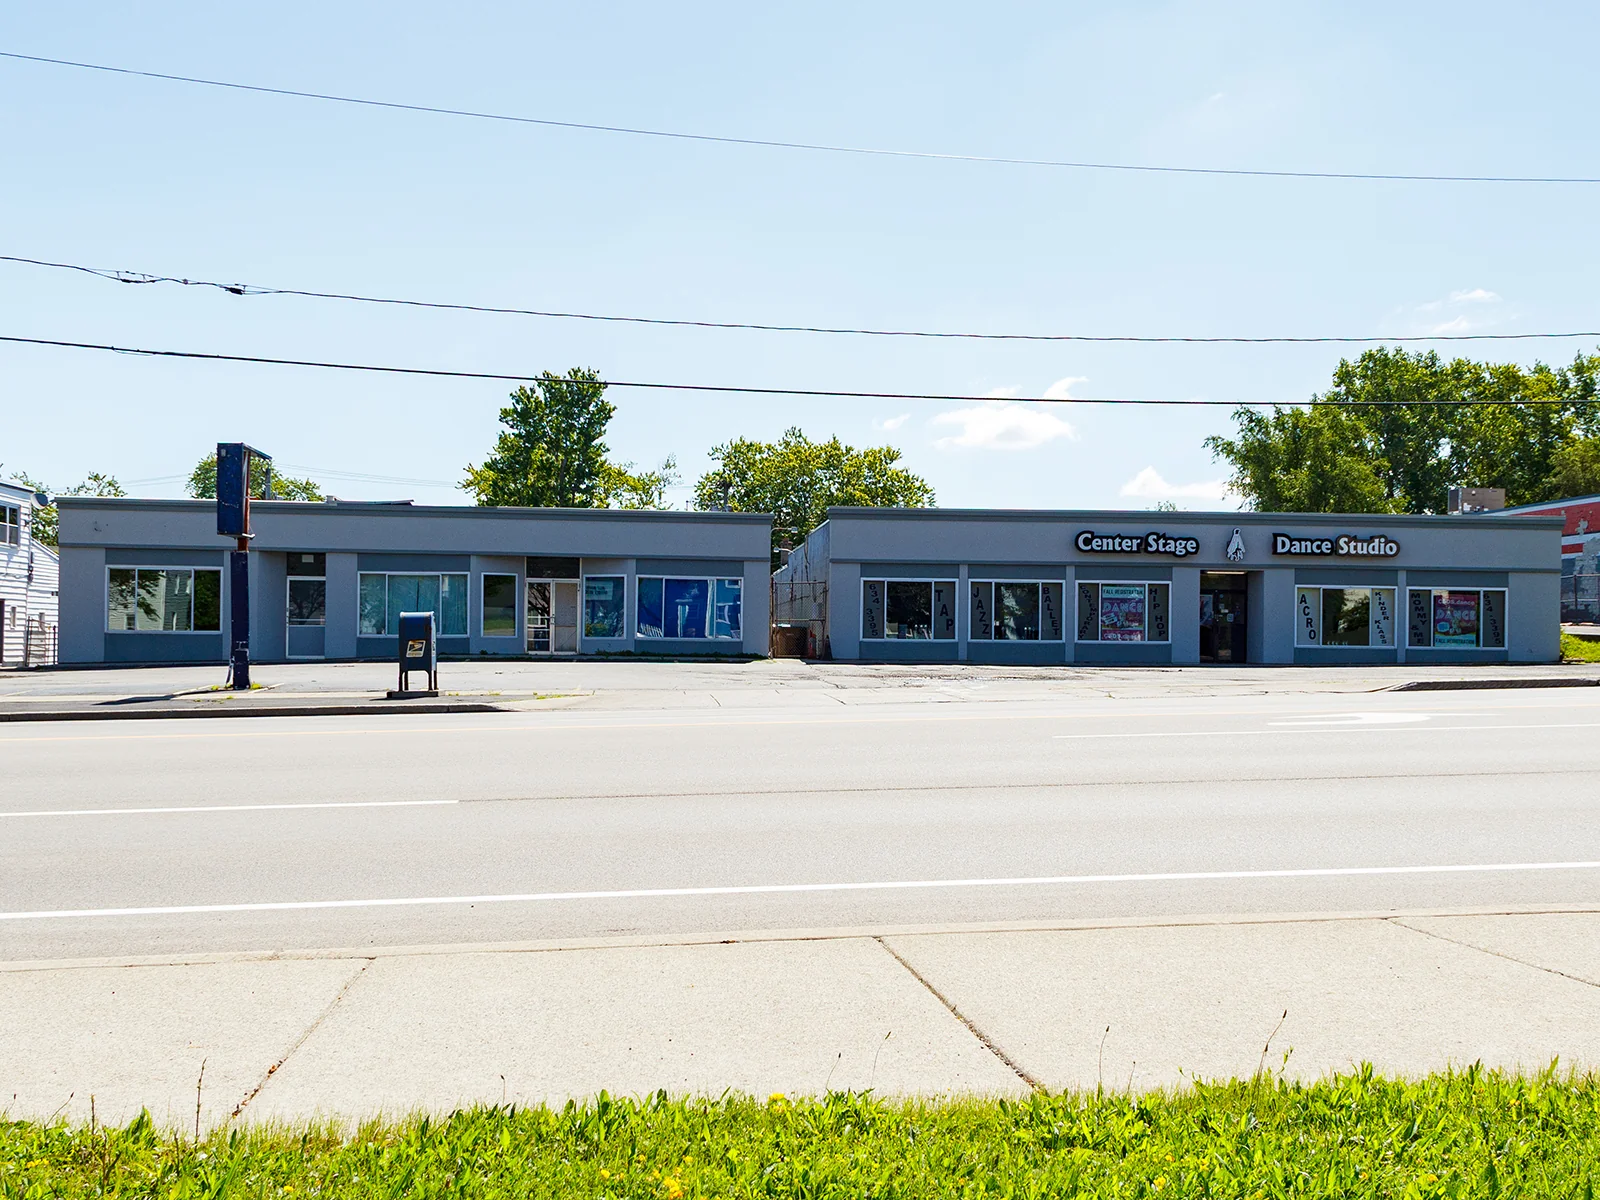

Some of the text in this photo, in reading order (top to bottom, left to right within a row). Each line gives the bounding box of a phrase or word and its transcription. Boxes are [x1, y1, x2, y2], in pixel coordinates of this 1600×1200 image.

[1077, 533, 1398, 555] Center Stage Dance Studio
[935, 589, 954, 631] TAP
[973, 587, 990, 635] JAZZ
[1042, 587, 1060, 636] BALLET
[1102, 602, 1143, 613] DANCE
[1149, 588, 1166, 637] HIP HOP
[1299, 593, 1317, 640] ACRO
[1374, 591, 1390, 644] KINDER KLASS
[1411, 593, 1427, 625] MOMMY
[1436, 609, 1477, 621] DANCE
[1413, 631, 1424, 645] ME
